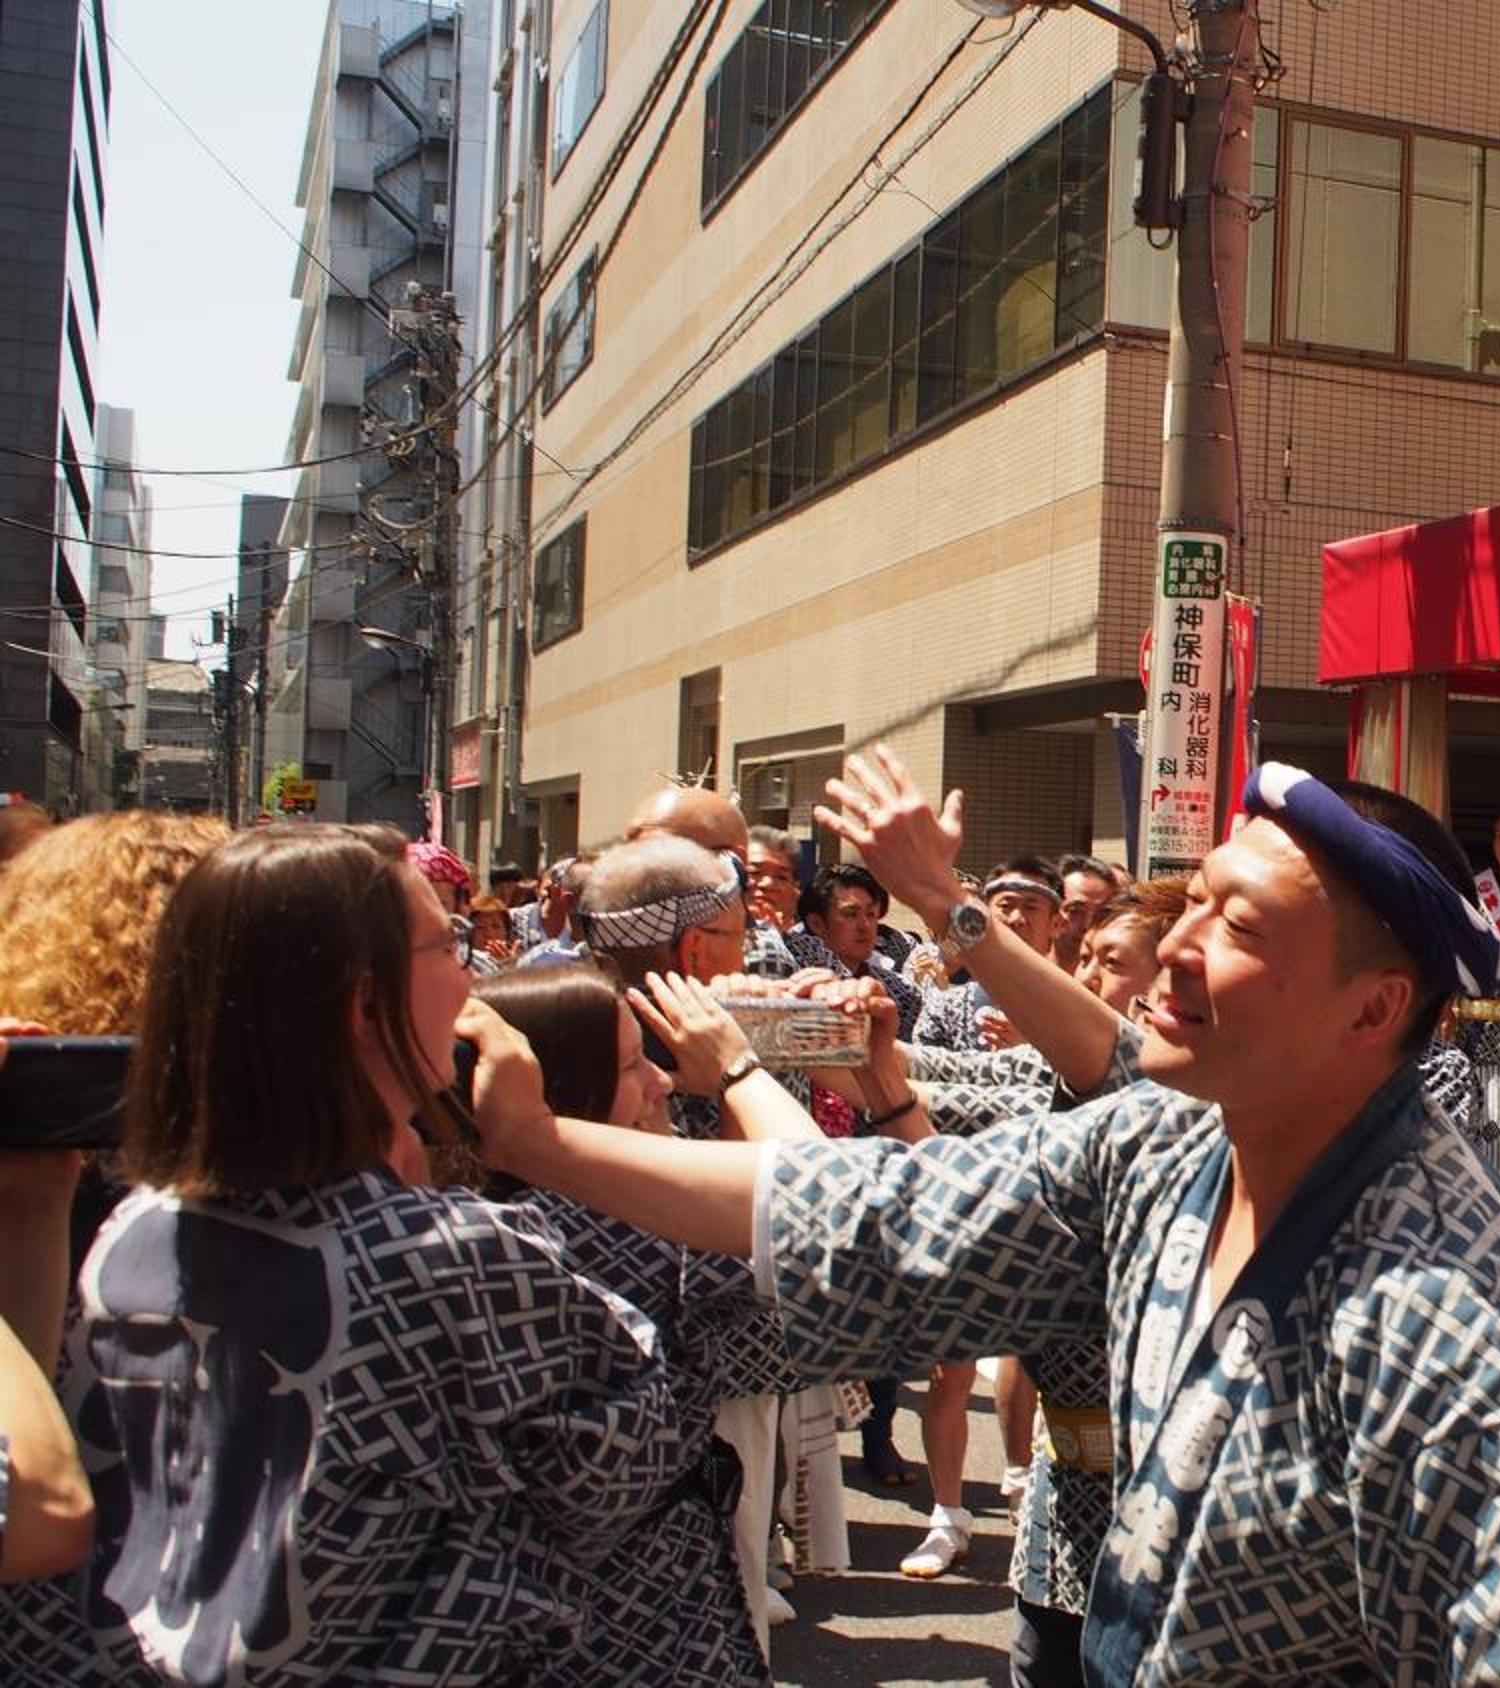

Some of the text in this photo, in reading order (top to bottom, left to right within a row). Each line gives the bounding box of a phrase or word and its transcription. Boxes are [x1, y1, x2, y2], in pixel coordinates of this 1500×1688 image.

[1172, 603, 1204, 688] 神保町
[1185, 691, 1211, 781] 消化器科
